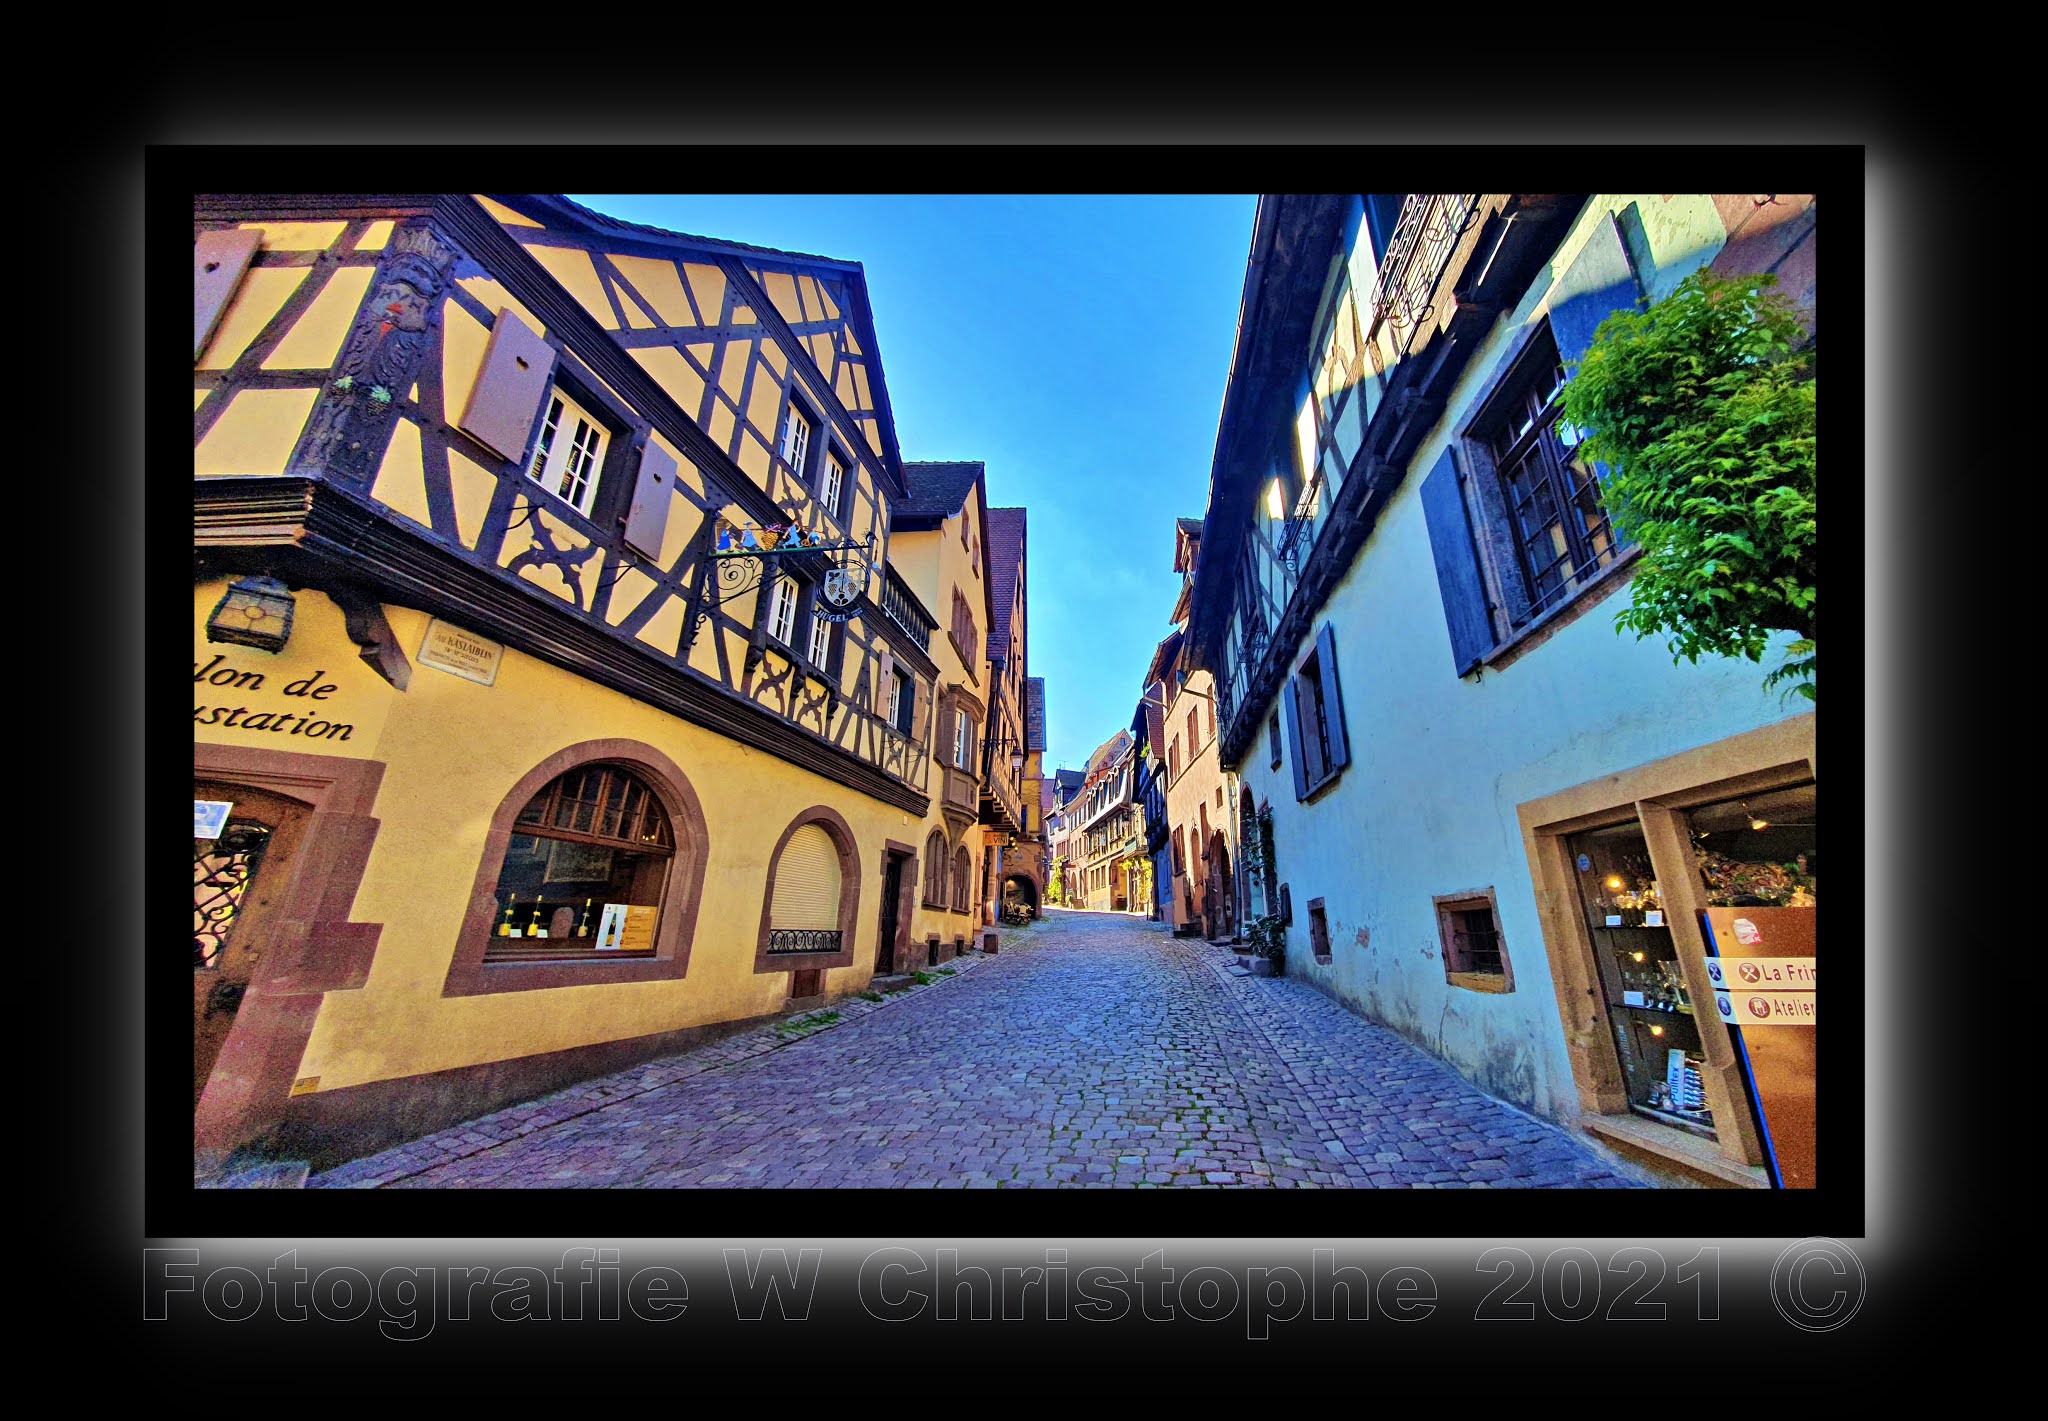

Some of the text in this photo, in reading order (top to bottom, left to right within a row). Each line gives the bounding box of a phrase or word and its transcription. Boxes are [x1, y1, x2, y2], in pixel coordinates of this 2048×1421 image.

[817, 610, 848, 622] HUGEL
[194, 654, 338, 700] lon de
[1761, 964, 1782, 981] La
[1774, 998, 1816, 1017] Atelier
